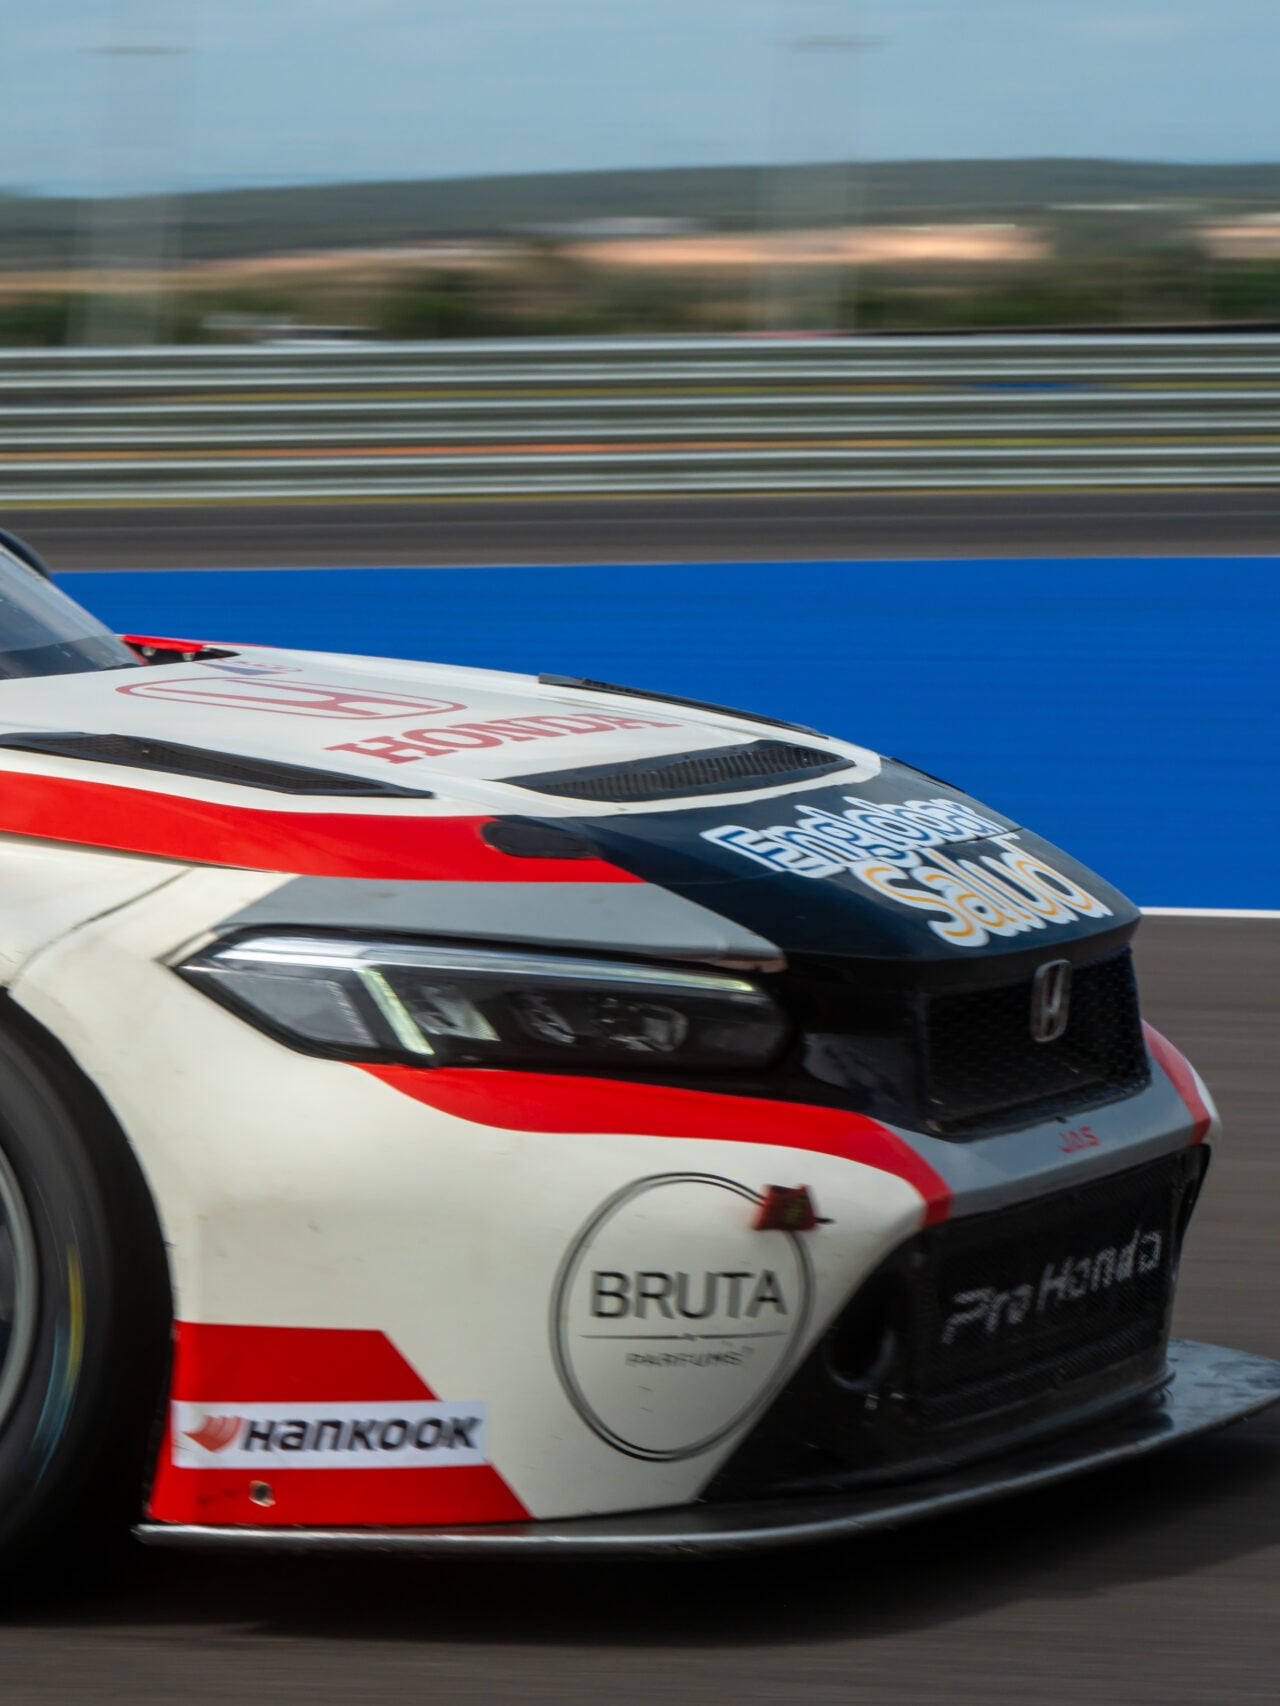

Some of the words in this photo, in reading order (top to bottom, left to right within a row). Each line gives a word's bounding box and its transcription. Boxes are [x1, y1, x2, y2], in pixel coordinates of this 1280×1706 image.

[323, 712, 685, 764] HONDA
[699, 796, 1020, 879] Englobar
[851, 834, 1114, 947] Salud
[589, 1269, 788, 1320] BRUTA
